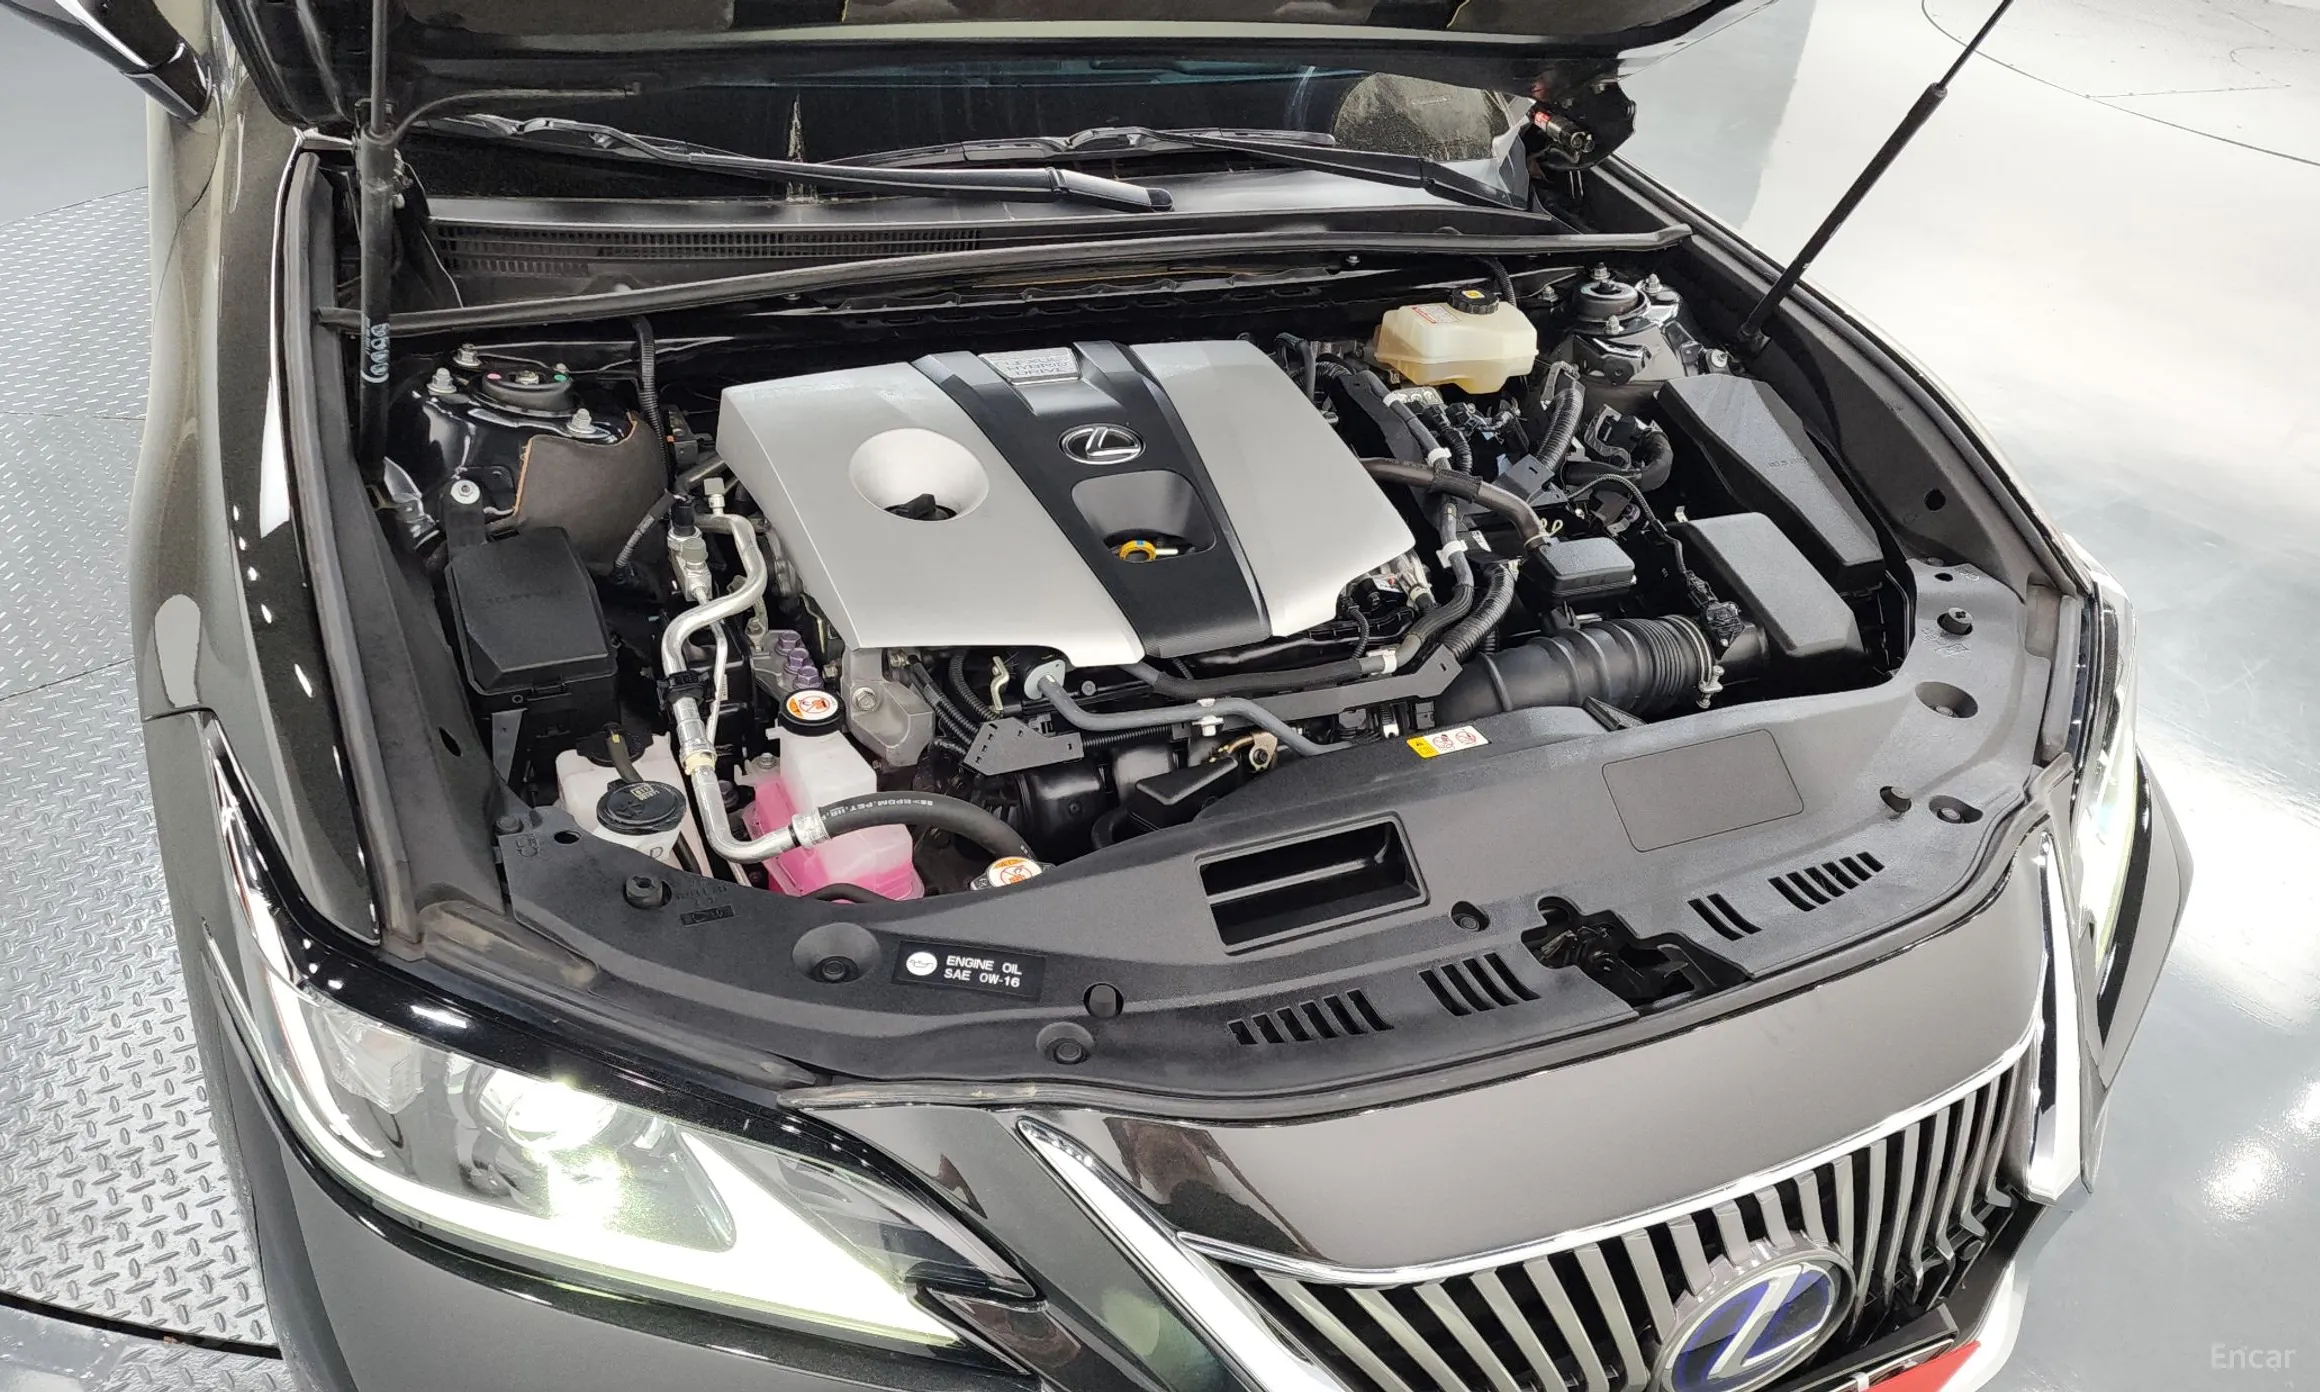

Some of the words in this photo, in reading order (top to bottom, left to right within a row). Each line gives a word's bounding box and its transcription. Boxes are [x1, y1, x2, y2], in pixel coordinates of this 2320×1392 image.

[946, 955, 994, 971] ENGINE
[1002, 962, 1023, 975] OIL
[944, 968, 972, 981] SAE
[979, 972, 1021, 988] 0W-16
